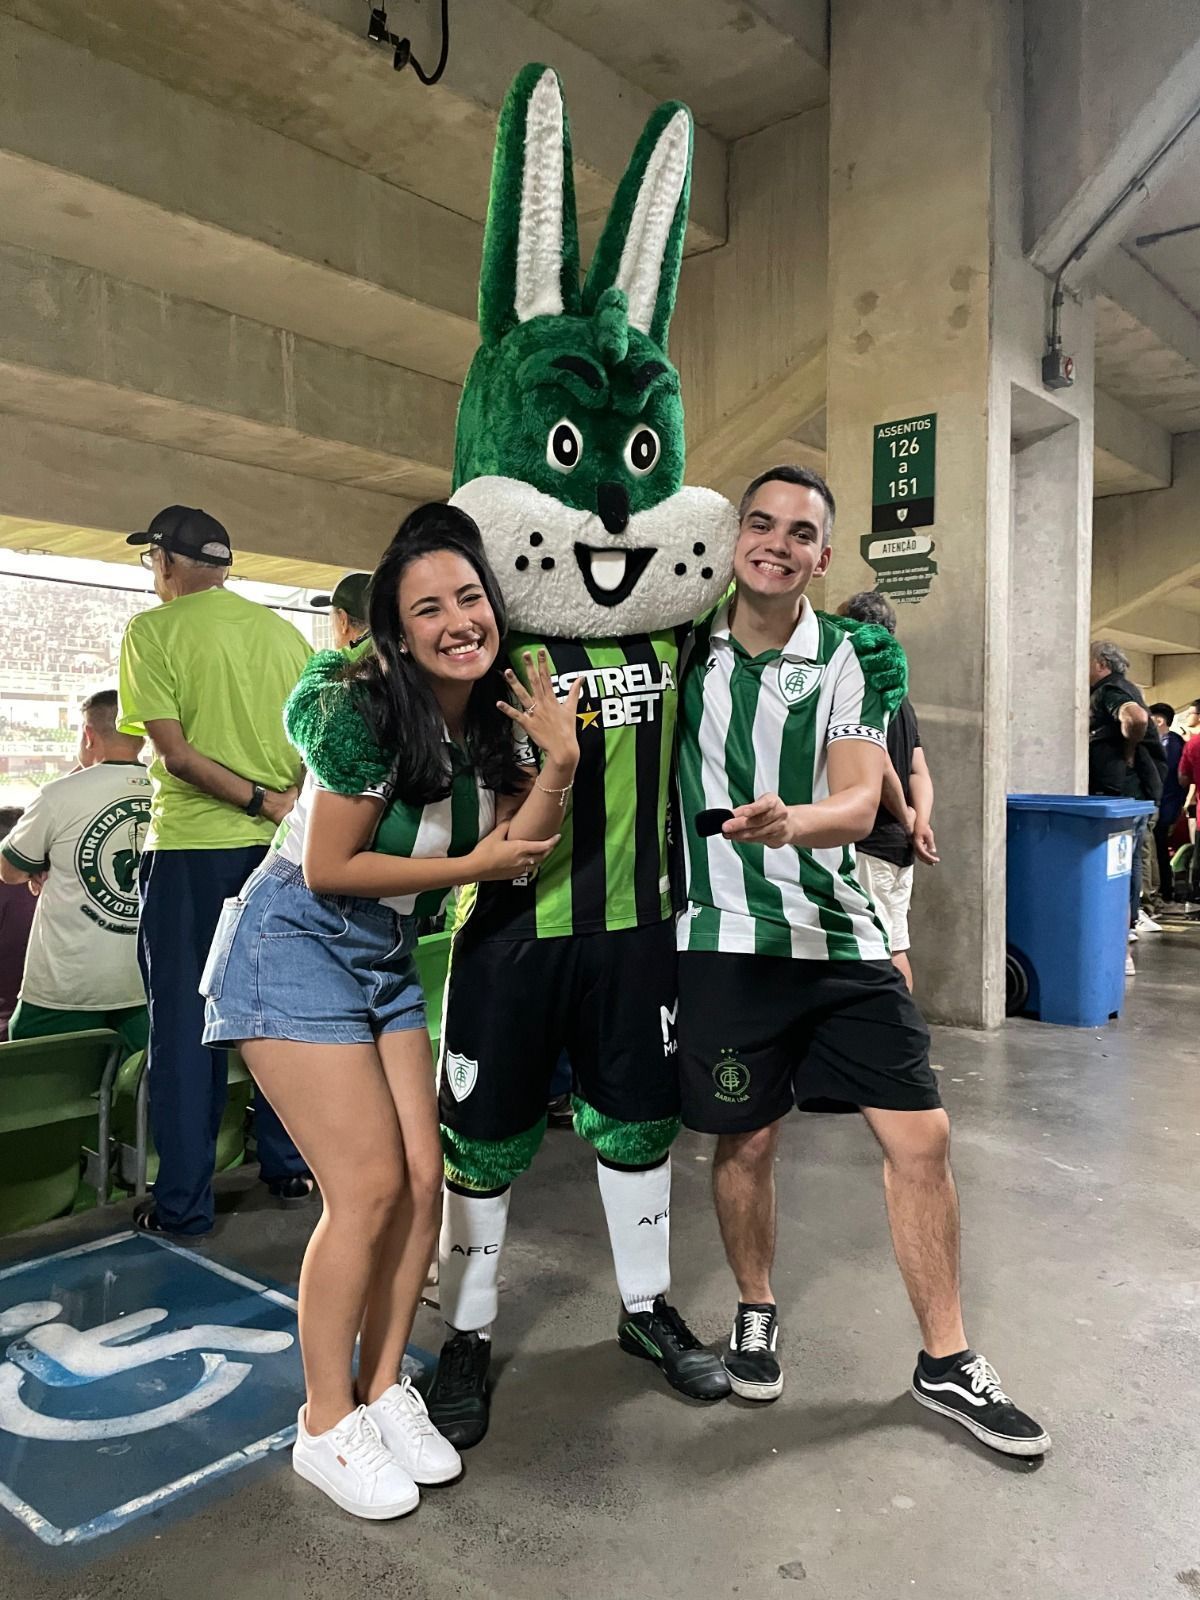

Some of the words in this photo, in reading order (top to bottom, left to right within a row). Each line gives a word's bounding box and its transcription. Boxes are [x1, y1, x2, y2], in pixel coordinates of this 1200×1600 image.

[877, 418, 931, 440] ASSENTOS
[889, 437, 920, 459] 126
[898, 461, 908, 474] a
[888, 477, 918, 498] 151
[882, 539, 917, 554] ATENÇÃO
[601, 693, 660, 728] BET
[82, 807, 127, 869] TORCIDA
[131, 802, 150, 813] SE
[96, 889, 139, 915] 11/09/
[664, 1039, 679, 1057] MA
[451, 1244, 498, 1257] AFC
